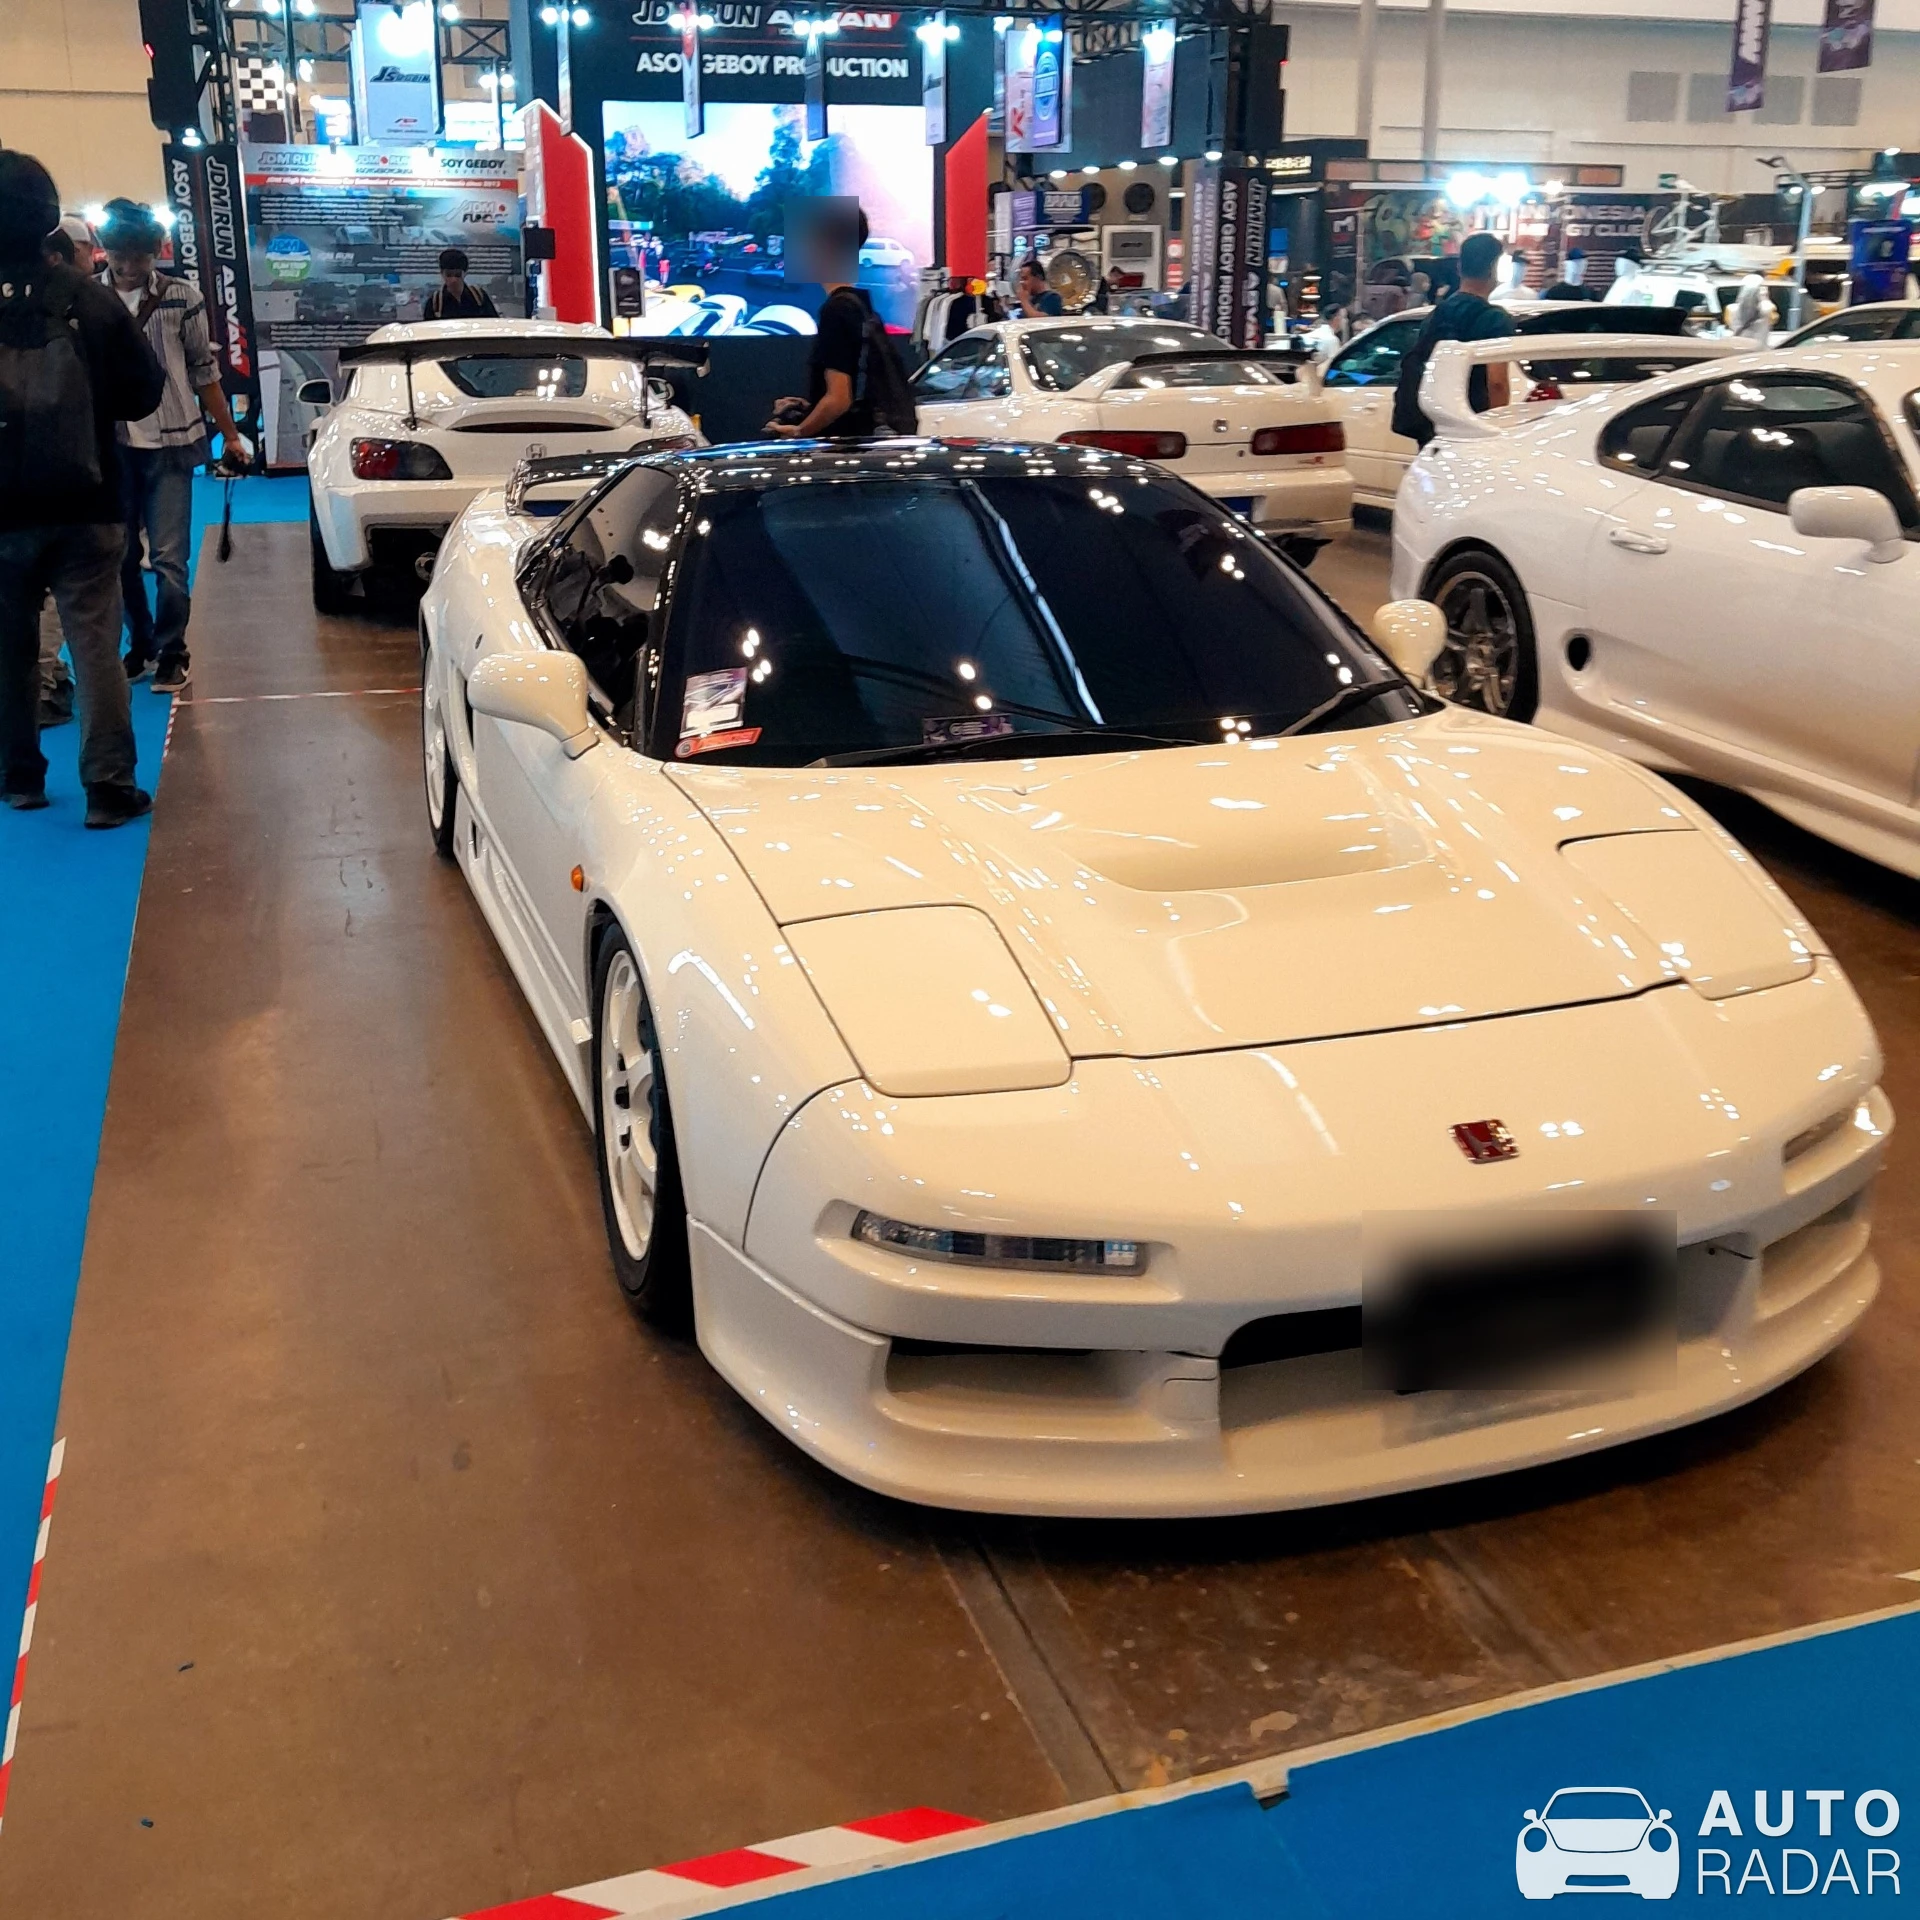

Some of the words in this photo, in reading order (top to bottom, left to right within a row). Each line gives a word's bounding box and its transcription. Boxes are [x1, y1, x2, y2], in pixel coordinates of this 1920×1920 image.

[702, 54, 770, 75] GEBOY
[773, 55, 909, 78] PRUCTION
[172, 158, 191, 207] ASOY
[465, 159, 505, 169] GEBOY
[1222, 180, 1238, 221] ASOY
[176, 211, 199, 270] GEBOY
[1218, 223, 1237, 274] GEBOY
[221, 264, 242, 366] ADVAN
